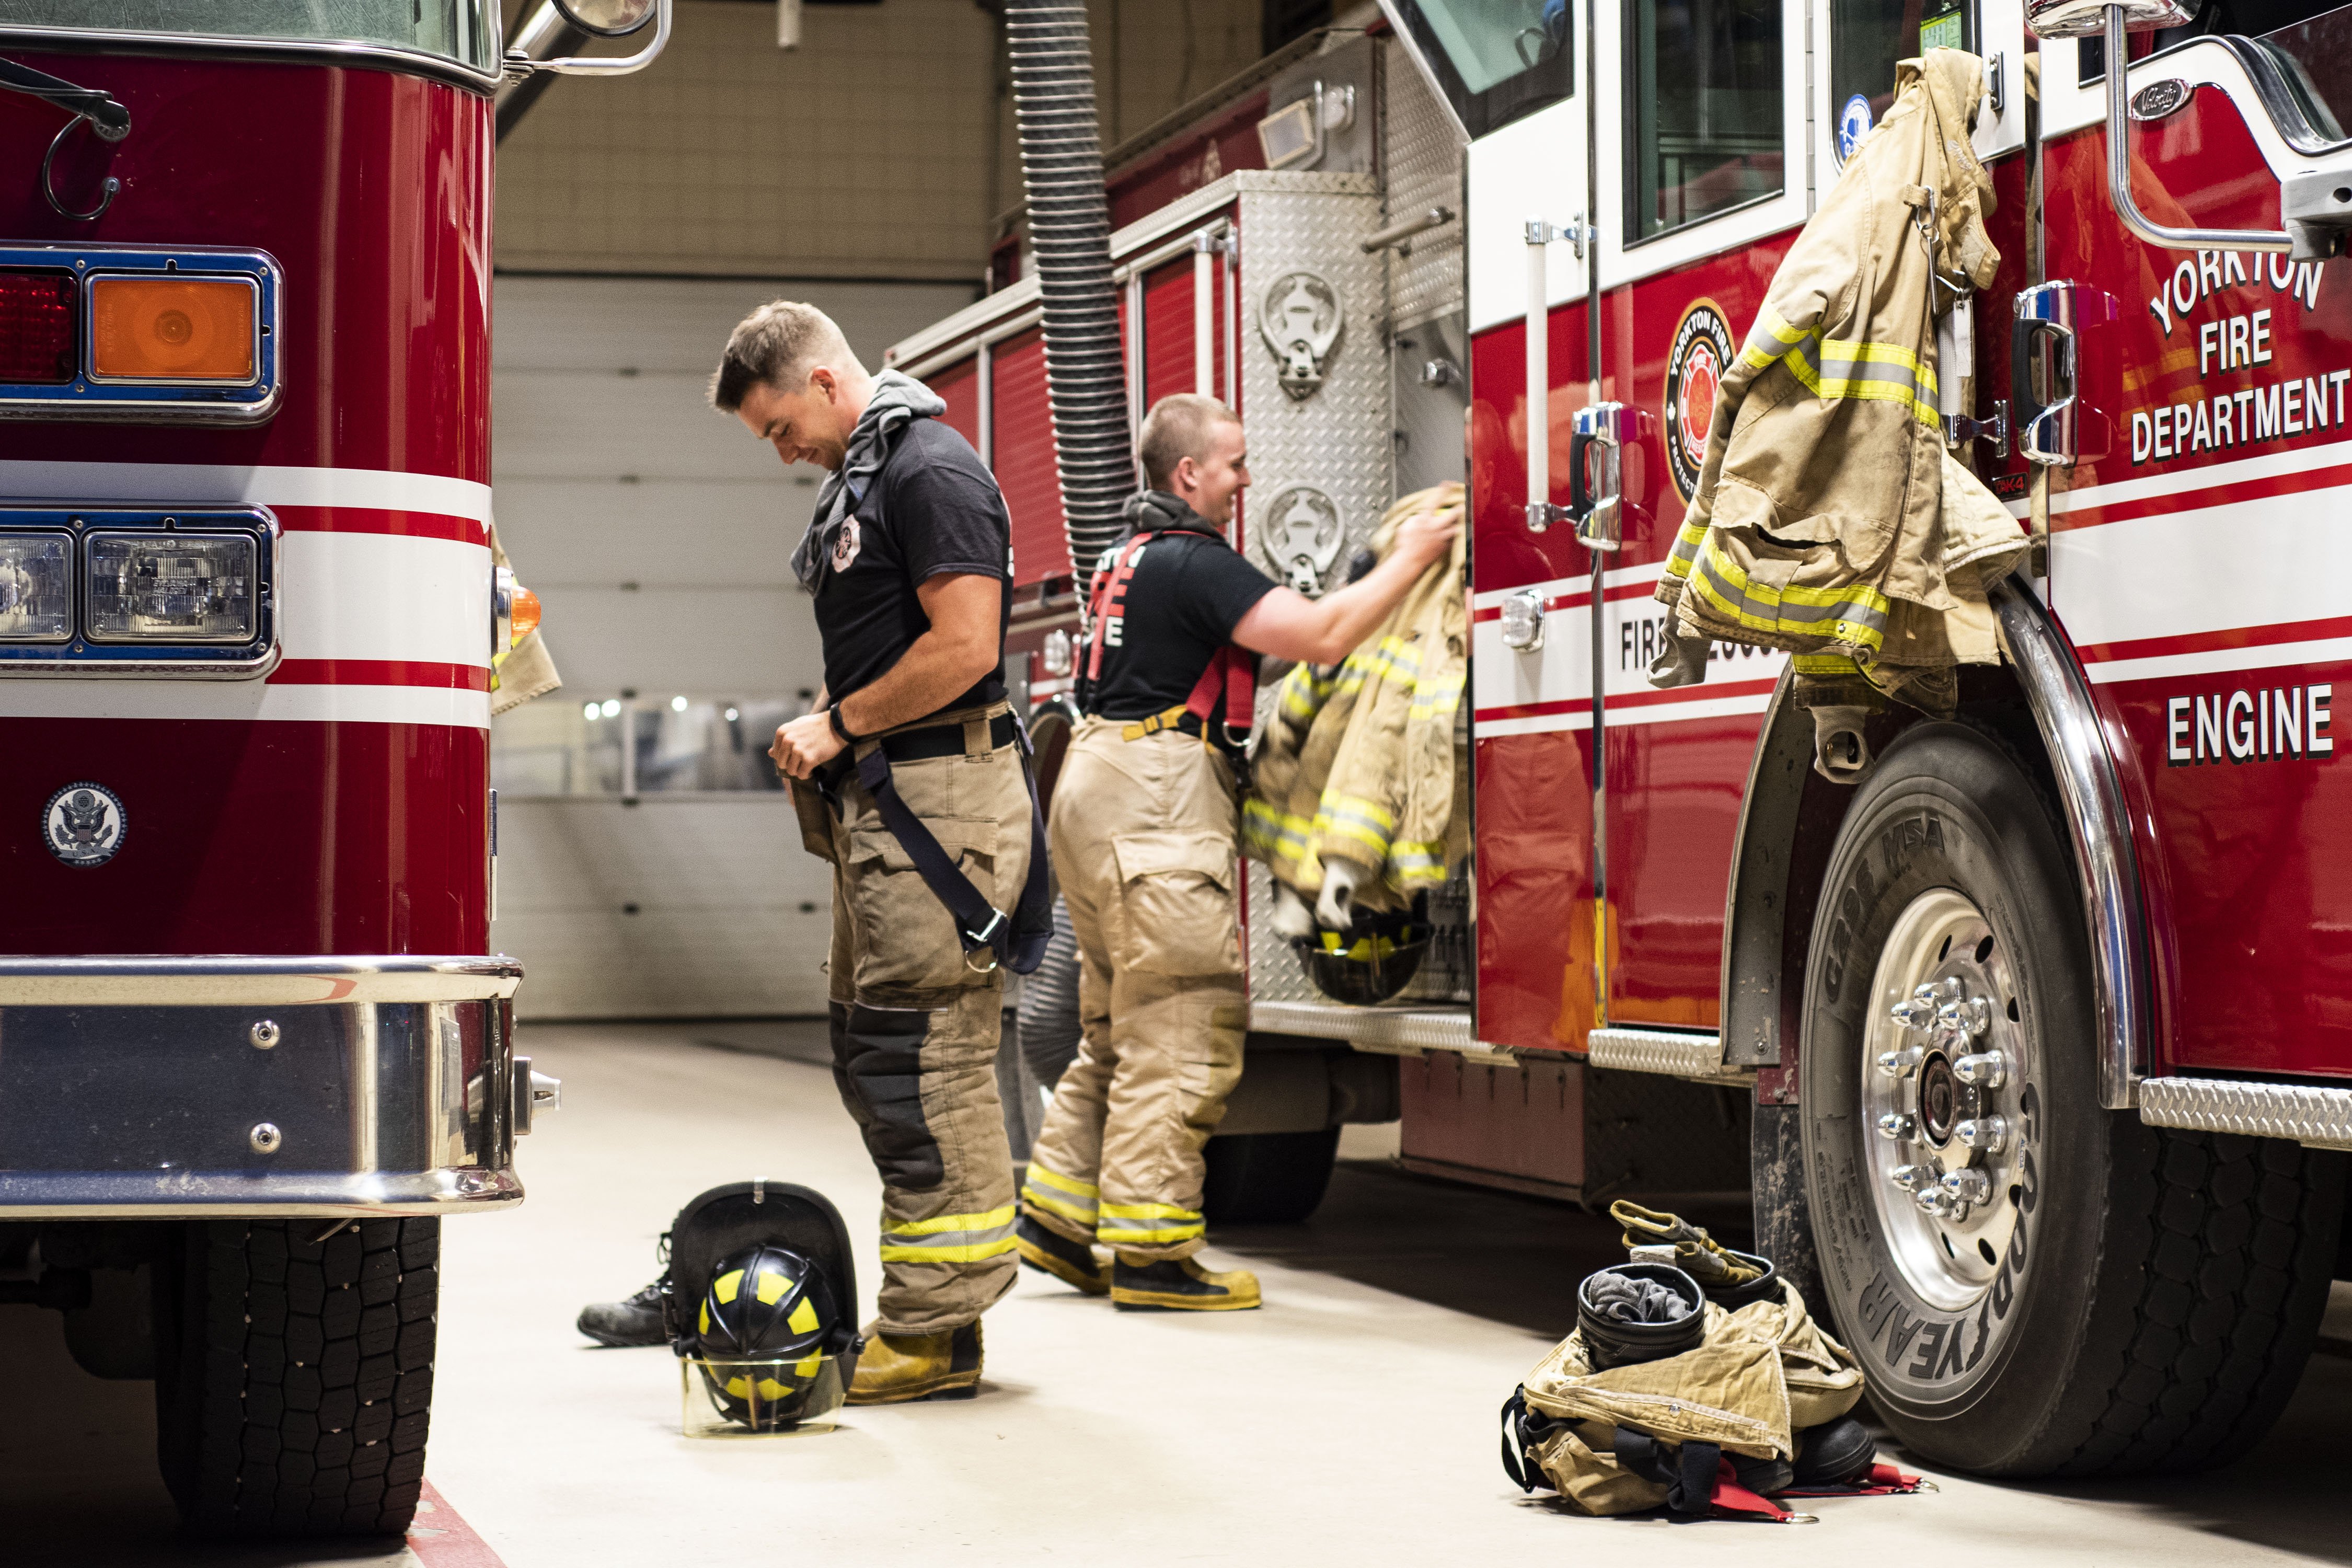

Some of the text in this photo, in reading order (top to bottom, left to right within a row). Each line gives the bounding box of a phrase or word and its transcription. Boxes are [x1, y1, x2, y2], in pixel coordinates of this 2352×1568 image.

[2142, 84, 2176, 113] Velocity
[1669, 310, 1731, 376] YORKTON FIRE
[2200, 309, 2272, 377] FIRE
[2132, 369, 2351, 465] DEPARTMENT
[2167, 683, 2333, 765] ENGINE
[1882, 816, 1945, 870] MSA
[1859, 1082, 2040, 1380] GOODYEAR
